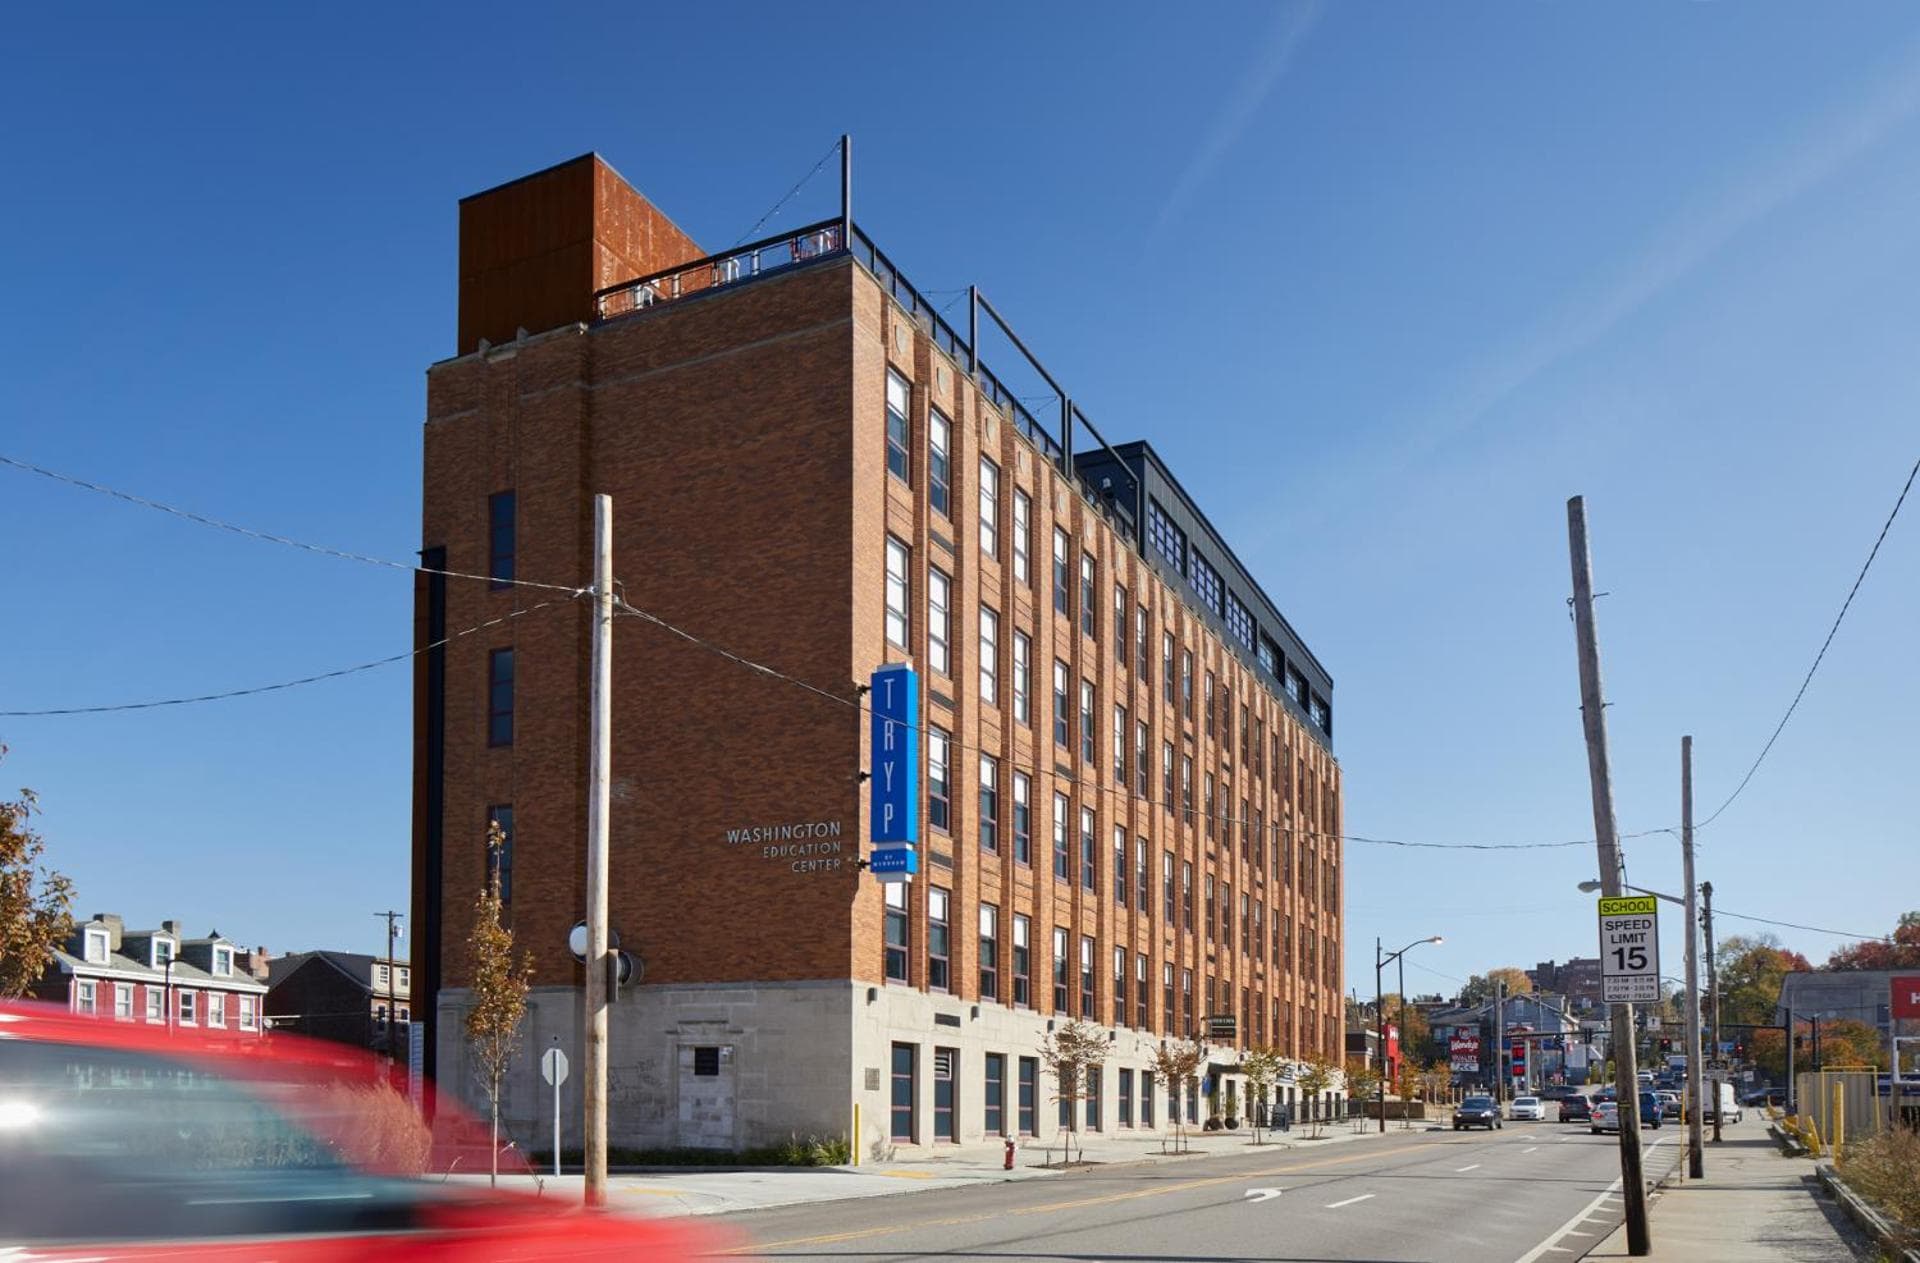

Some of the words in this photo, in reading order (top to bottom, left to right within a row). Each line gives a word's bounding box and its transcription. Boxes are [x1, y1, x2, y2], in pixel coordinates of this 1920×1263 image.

[883, 678, 895, 834] TRYP
[727, 821, 841, 844] WASHINGTON
[763, 841, 841, 858] EDUCATION
[791, 858, 841, 873] CENTER
[1602, 900, 1653, 913] SCHOOL
[1605, 919, 1652, 931] SPEED
[1610, 932, 1646, 943] LIMIT
[1611, 946, 1648, 970] 15
